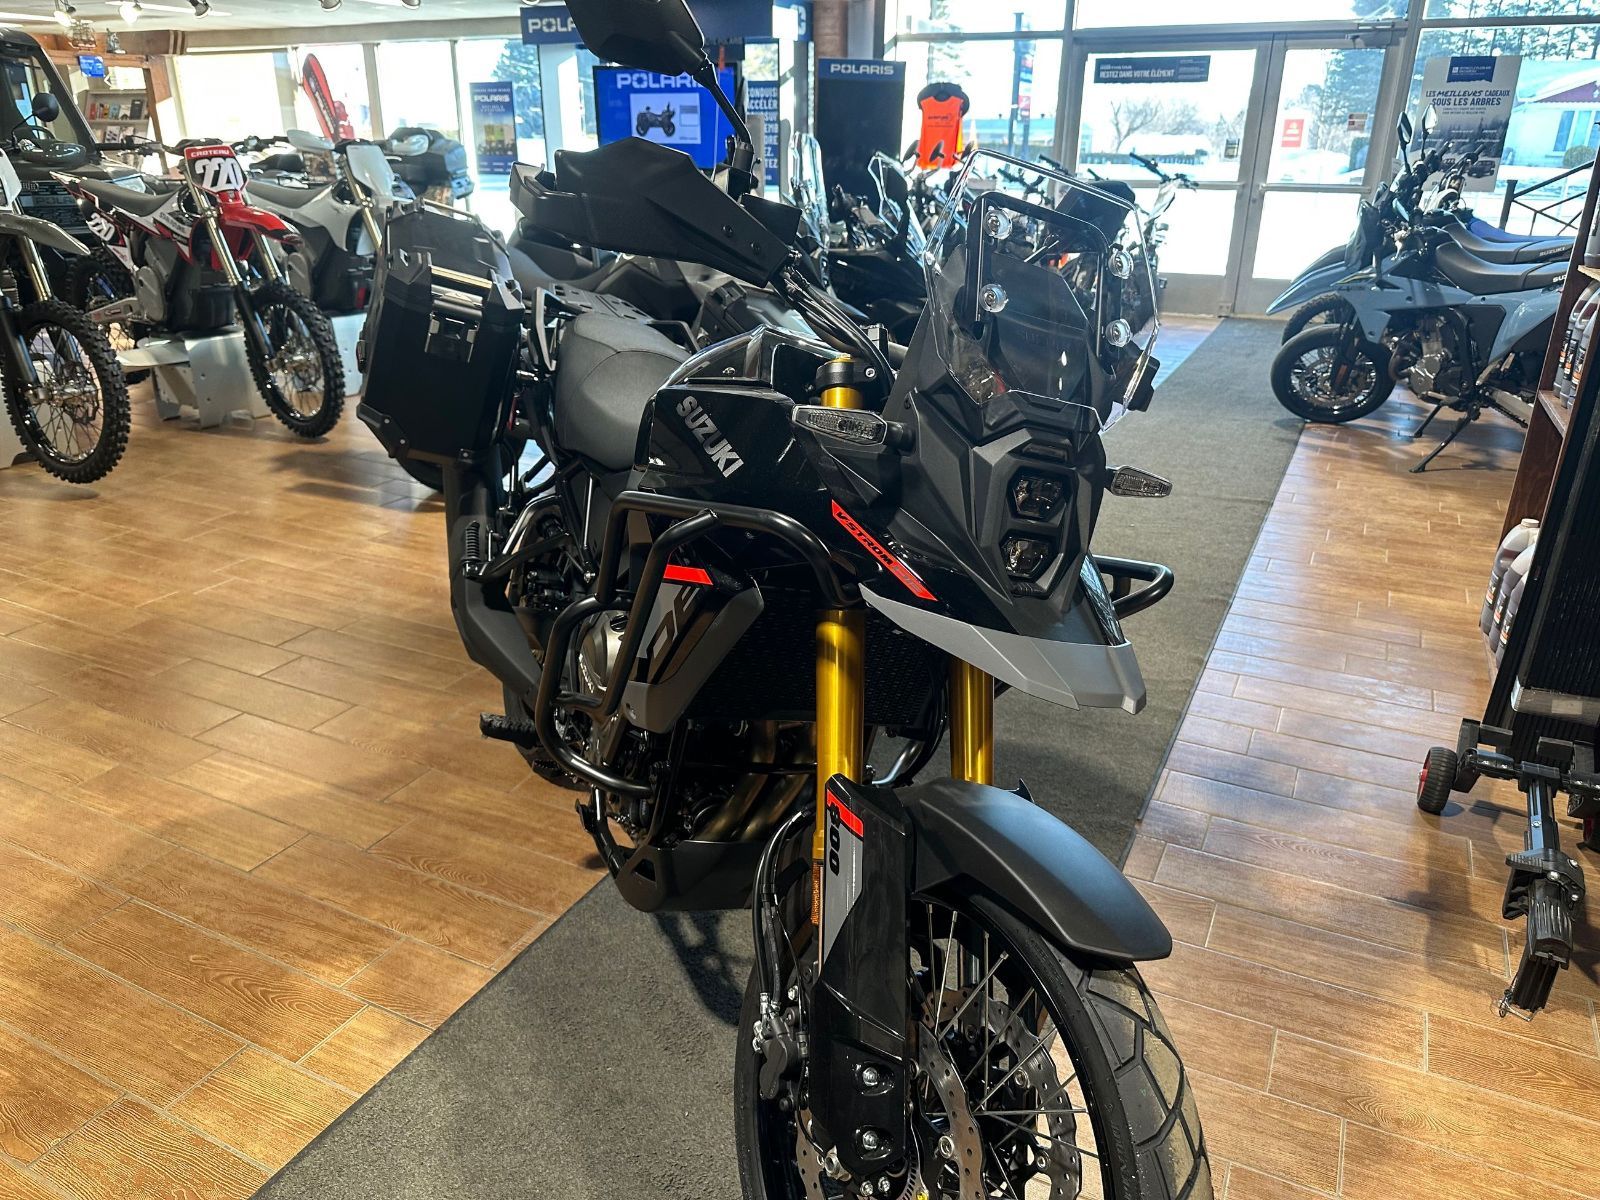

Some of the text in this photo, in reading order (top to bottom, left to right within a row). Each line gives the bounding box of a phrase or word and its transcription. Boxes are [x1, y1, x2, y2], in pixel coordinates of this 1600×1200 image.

[830, 63, 894, 75] POLARIS
[1119, 70, 1133, 78] DANS
[1133, 69, 1150, 78] VOTRE
[1484, 89, 1511, 97] CADEAUX
[1432, 97, 1502, 106] SOUS LES ARBRES
[190, 149, 230, 158] CROTEAU
[195, 157, 245, 193] 220
[86, 212, 115, 241] 220
[1539, 246, 1566, 257] SUZUKI
[676, 395, 745, 478] SUZUKI
[828, 804, 841, 877] 800
